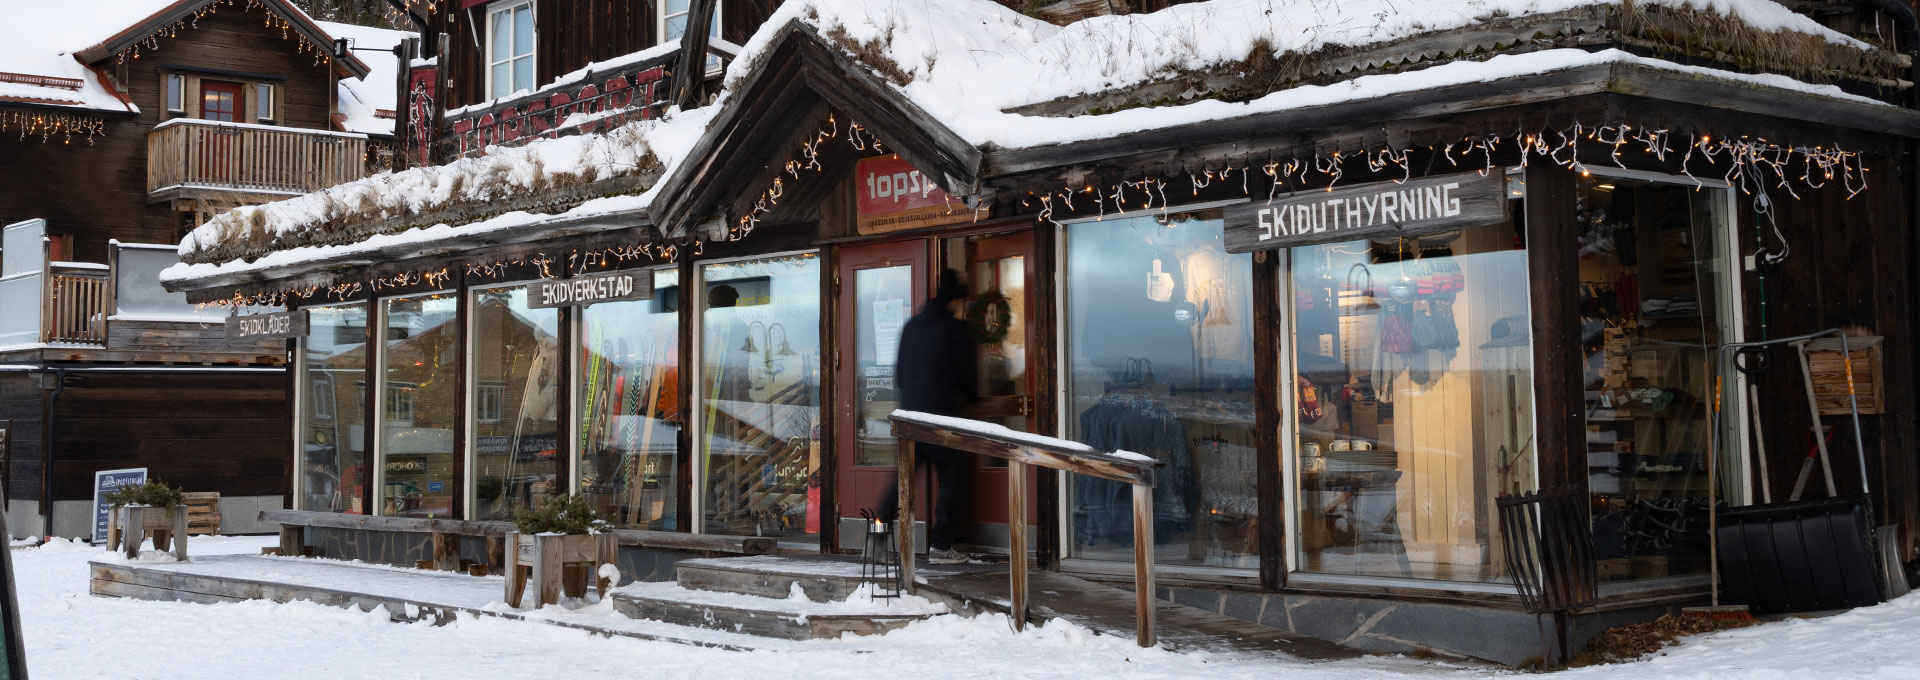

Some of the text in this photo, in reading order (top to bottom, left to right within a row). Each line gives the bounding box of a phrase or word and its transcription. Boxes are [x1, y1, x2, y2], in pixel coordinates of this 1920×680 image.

[453, 64, 666, 158] TOPSPORT
[866, 169, 938, 203] topsp
[1258, 182, 1461, 242] SKIDUTHYRNING
[542, 275, 633, 305] SKIDVERKSTAD
[240, 315, 290, 337] SKIDKLÄDER
